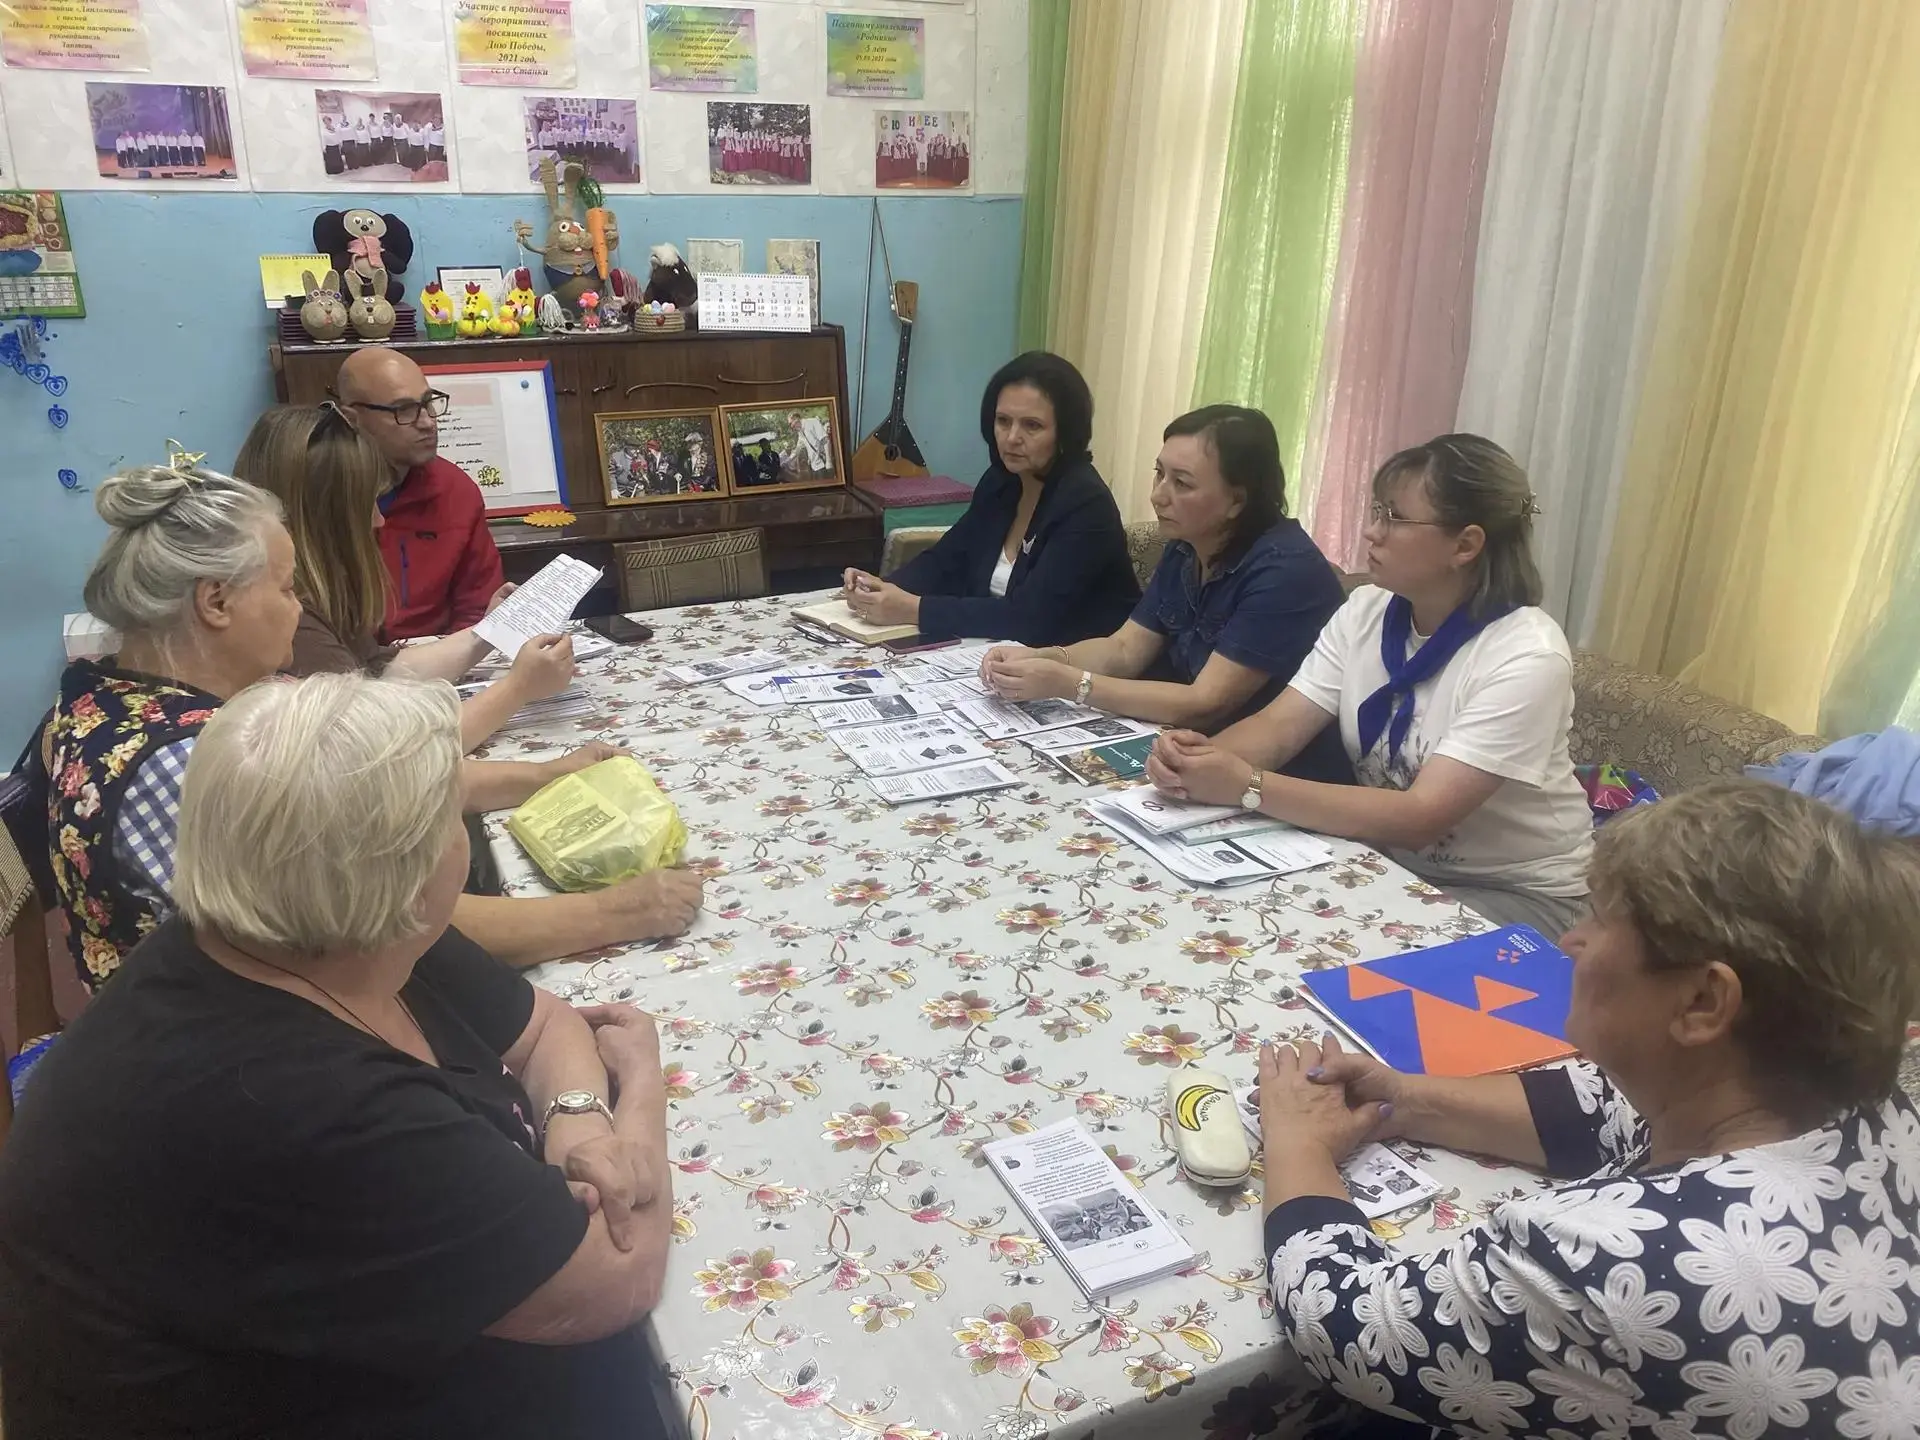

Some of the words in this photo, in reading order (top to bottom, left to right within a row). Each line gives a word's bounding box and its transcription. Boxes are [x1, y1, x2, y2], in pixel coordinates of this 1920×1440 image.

[459, 1, 499, 12] Участие
[509, 6, 567, 15] праздничных
[480, 17, 549, 27] мероприятиях,
[832, 19, 874, 29] Песенному
[486, 30, 548, 39] посвященных
[486, 40, 506, 50] Дню
[509, 41, 546, 51] Победы,
[498, 53, 518, 62] 2021
[513, 66, 548, 76] Станки
